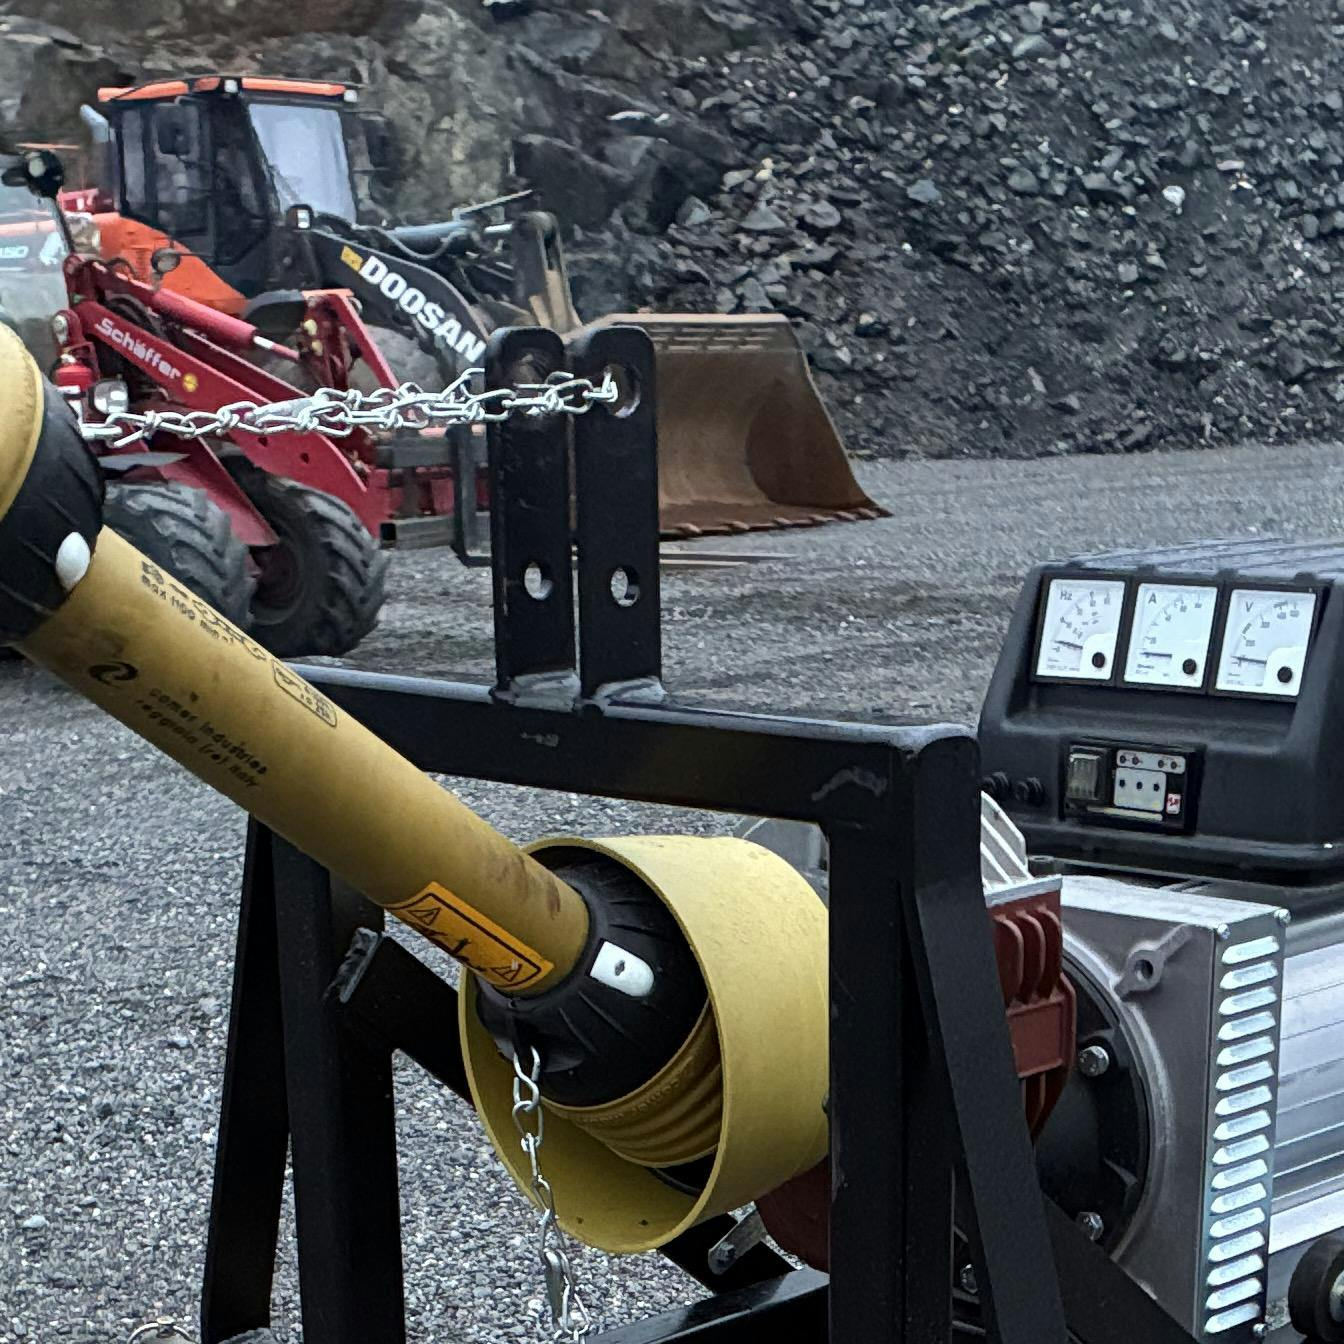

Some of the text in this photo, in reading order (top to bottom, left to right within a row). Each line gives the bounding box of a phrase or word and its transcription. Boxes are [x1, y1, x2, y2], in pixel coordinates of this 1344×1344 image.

[358, 255, 487, 363] DOOSAN
[1059, 590, 1073, 601] Hz
[1147, 592, 1157, 605] A
[1244, 601, 1255, 613] V
